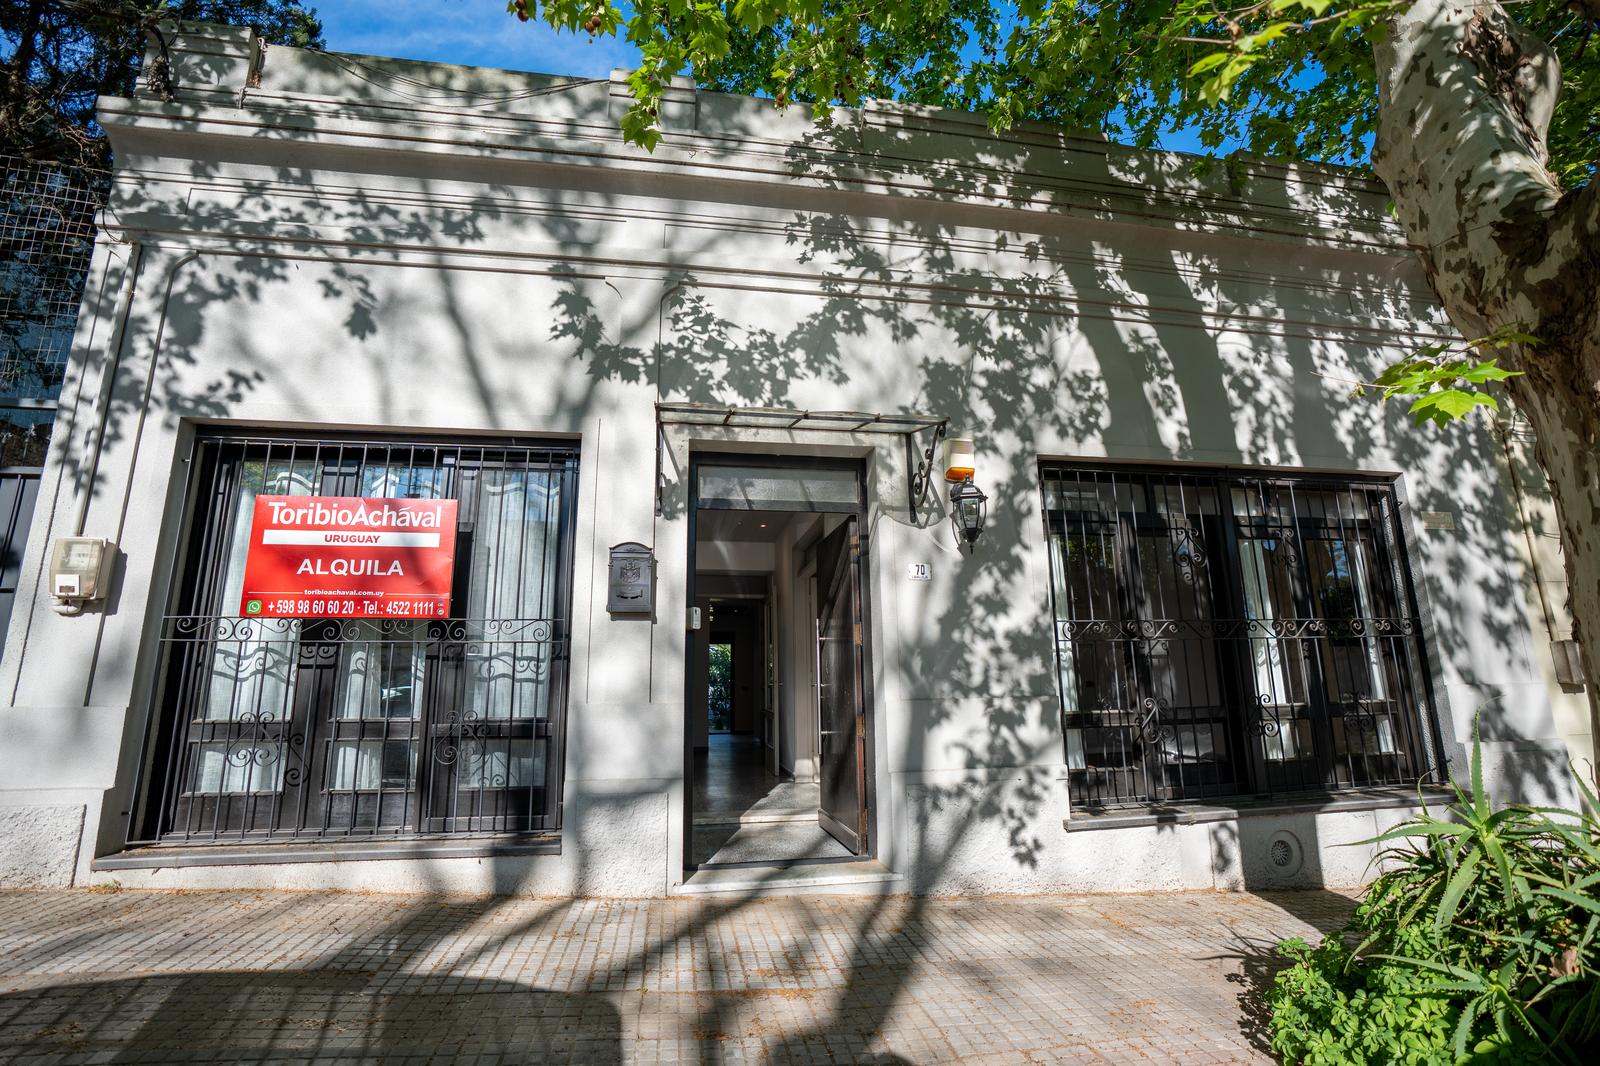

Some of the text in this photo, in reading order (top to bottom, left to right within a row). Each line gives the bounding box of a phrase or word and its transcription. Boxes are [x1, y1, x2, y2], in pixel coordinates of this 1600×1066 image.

[268, 502, 442, 528] ToribioAchával
[324, 534, 381, 544] URUGUAY
[296, 558, 404, 576] ALQUILA
[915, 564, 925, 575] 70
[303, 589, 385, 597] toribioachaval.com.uy
[297, 600, 310, 614] 98
[312, 600, 325, 614] 60
[327, 600, 340, 614] 60
[342, 600, 354, 614] 20
[363, 601, 383, 615] Tel.:
[386, 601, 410, 615] 4522
[413, 601, 434, 615] 1111
